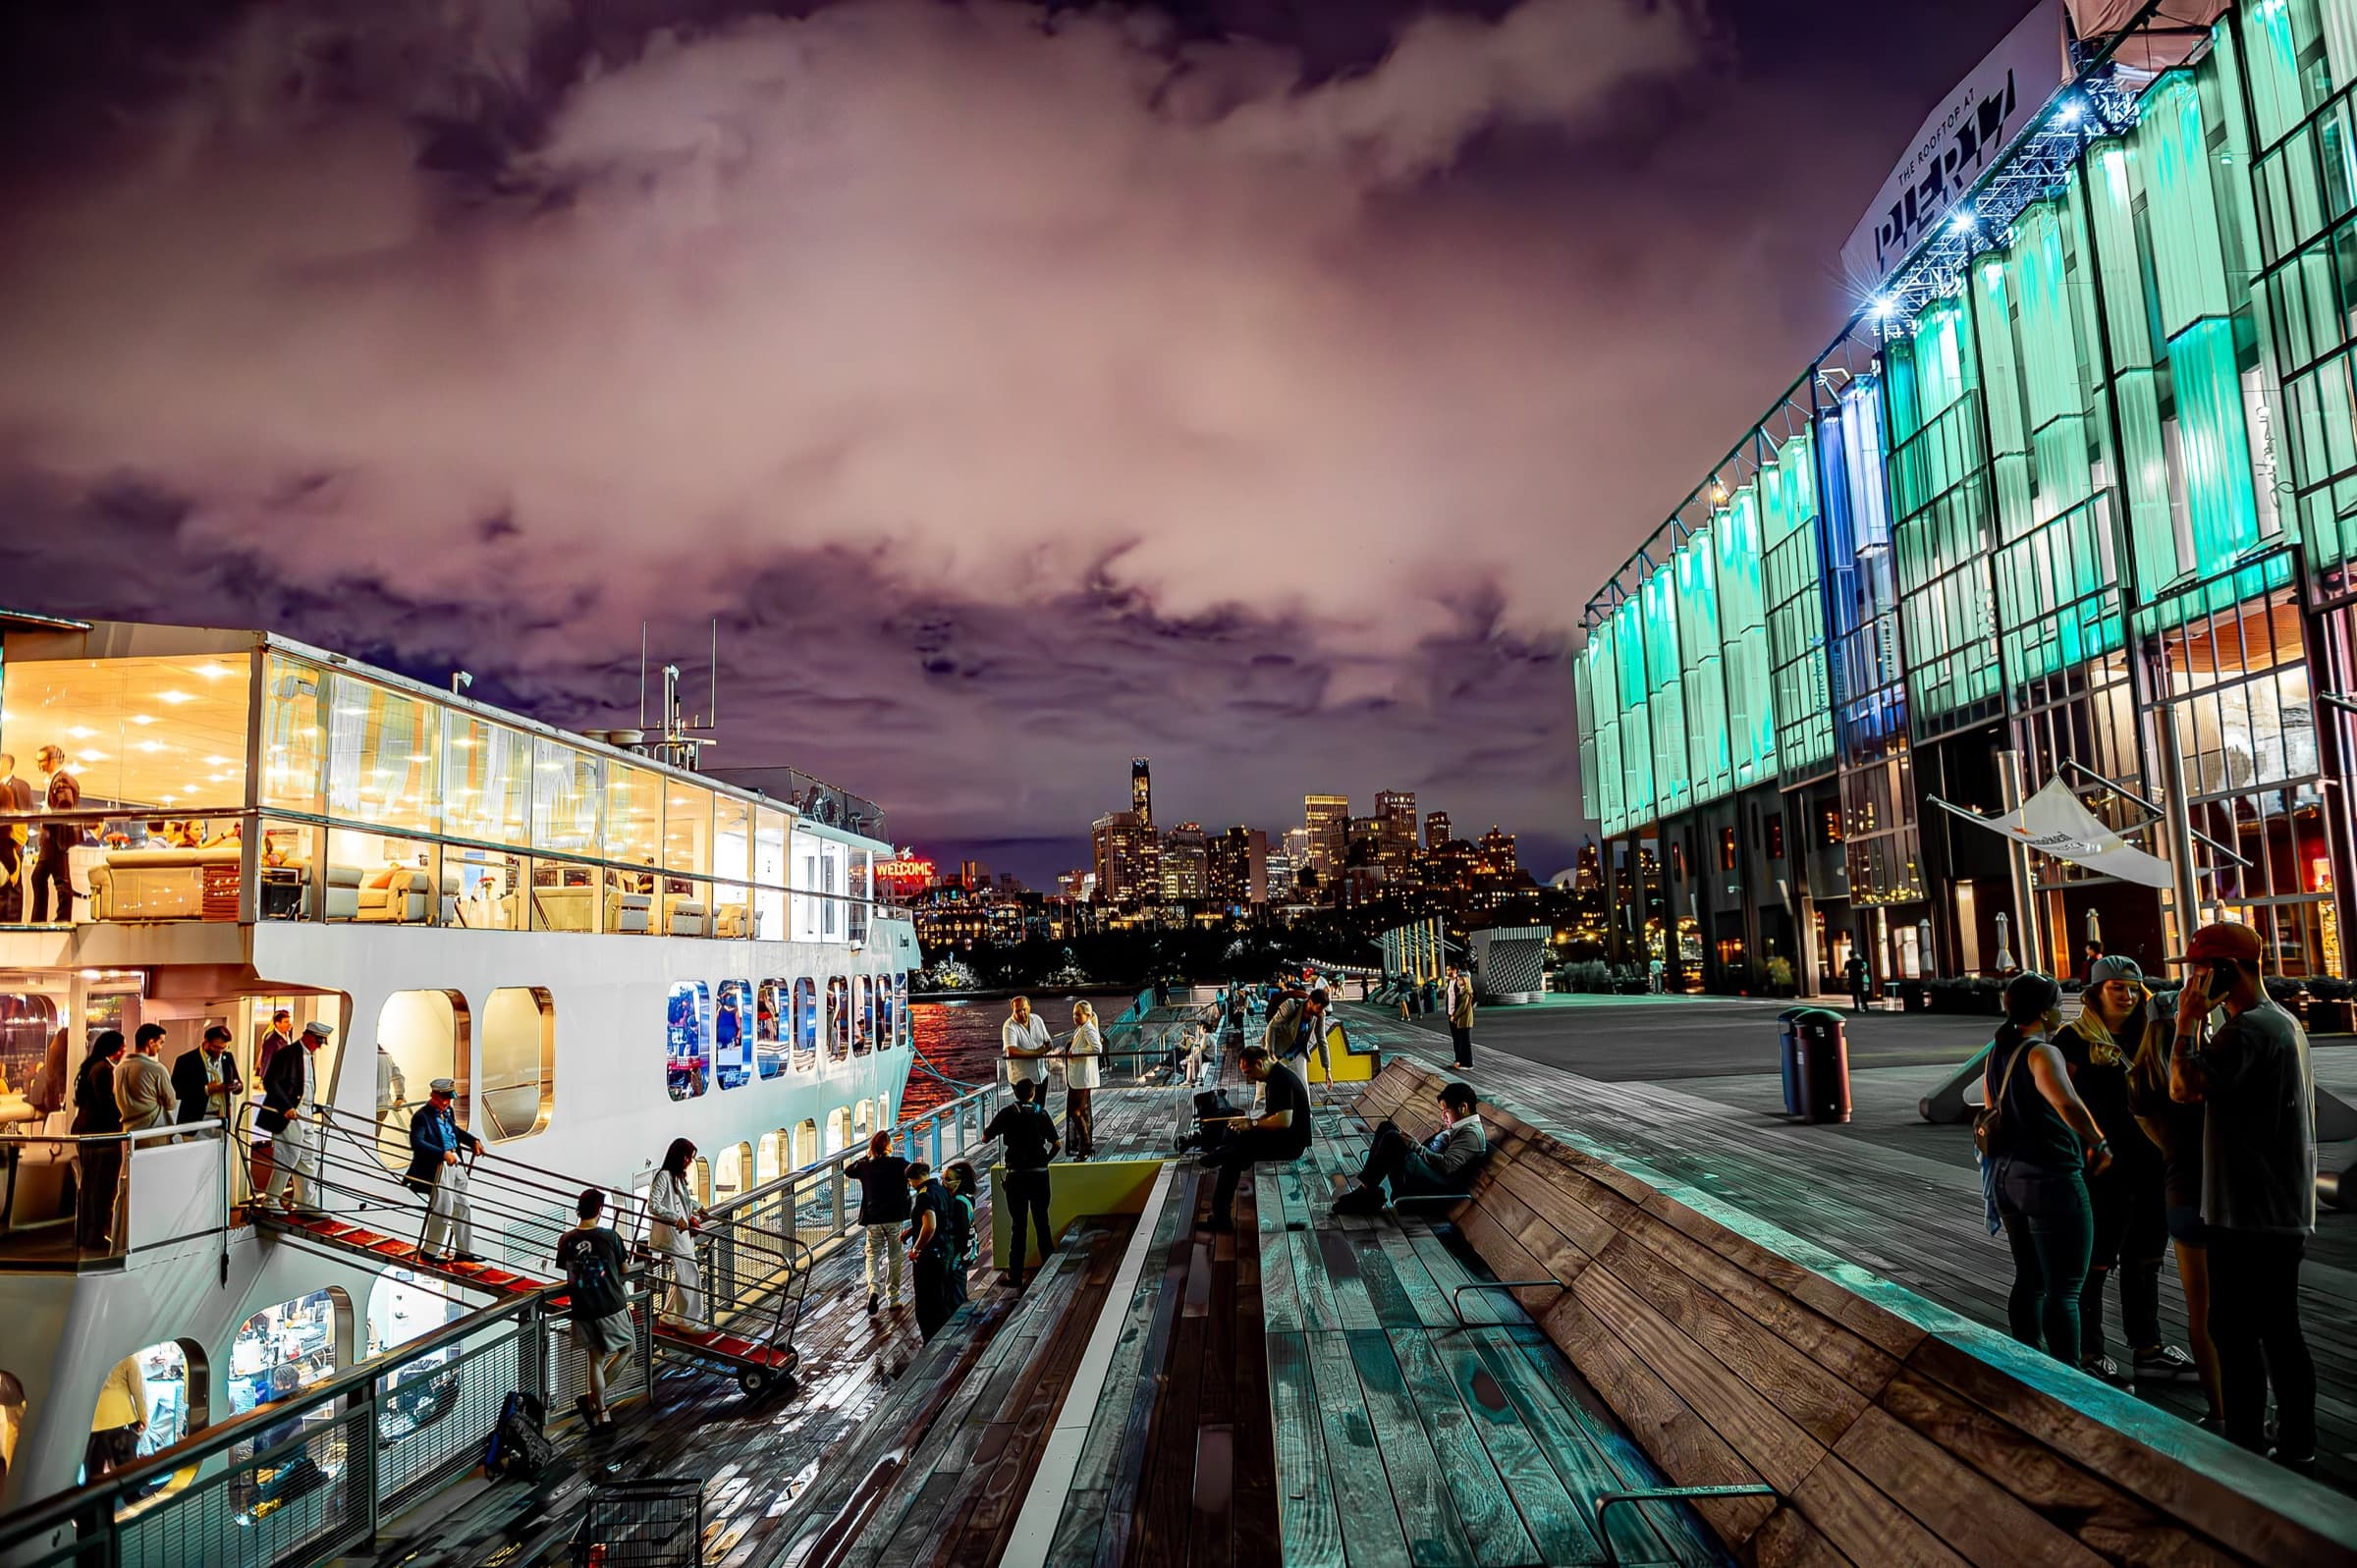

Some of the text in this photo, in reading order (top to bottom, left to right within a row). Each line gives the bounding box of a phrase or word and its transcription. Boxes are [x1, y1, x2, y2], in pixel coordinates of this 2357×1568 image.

[1898, 86, 1974, 187] THE ROOFTOP AT
[876, 862, 932, 876] WELCOME
